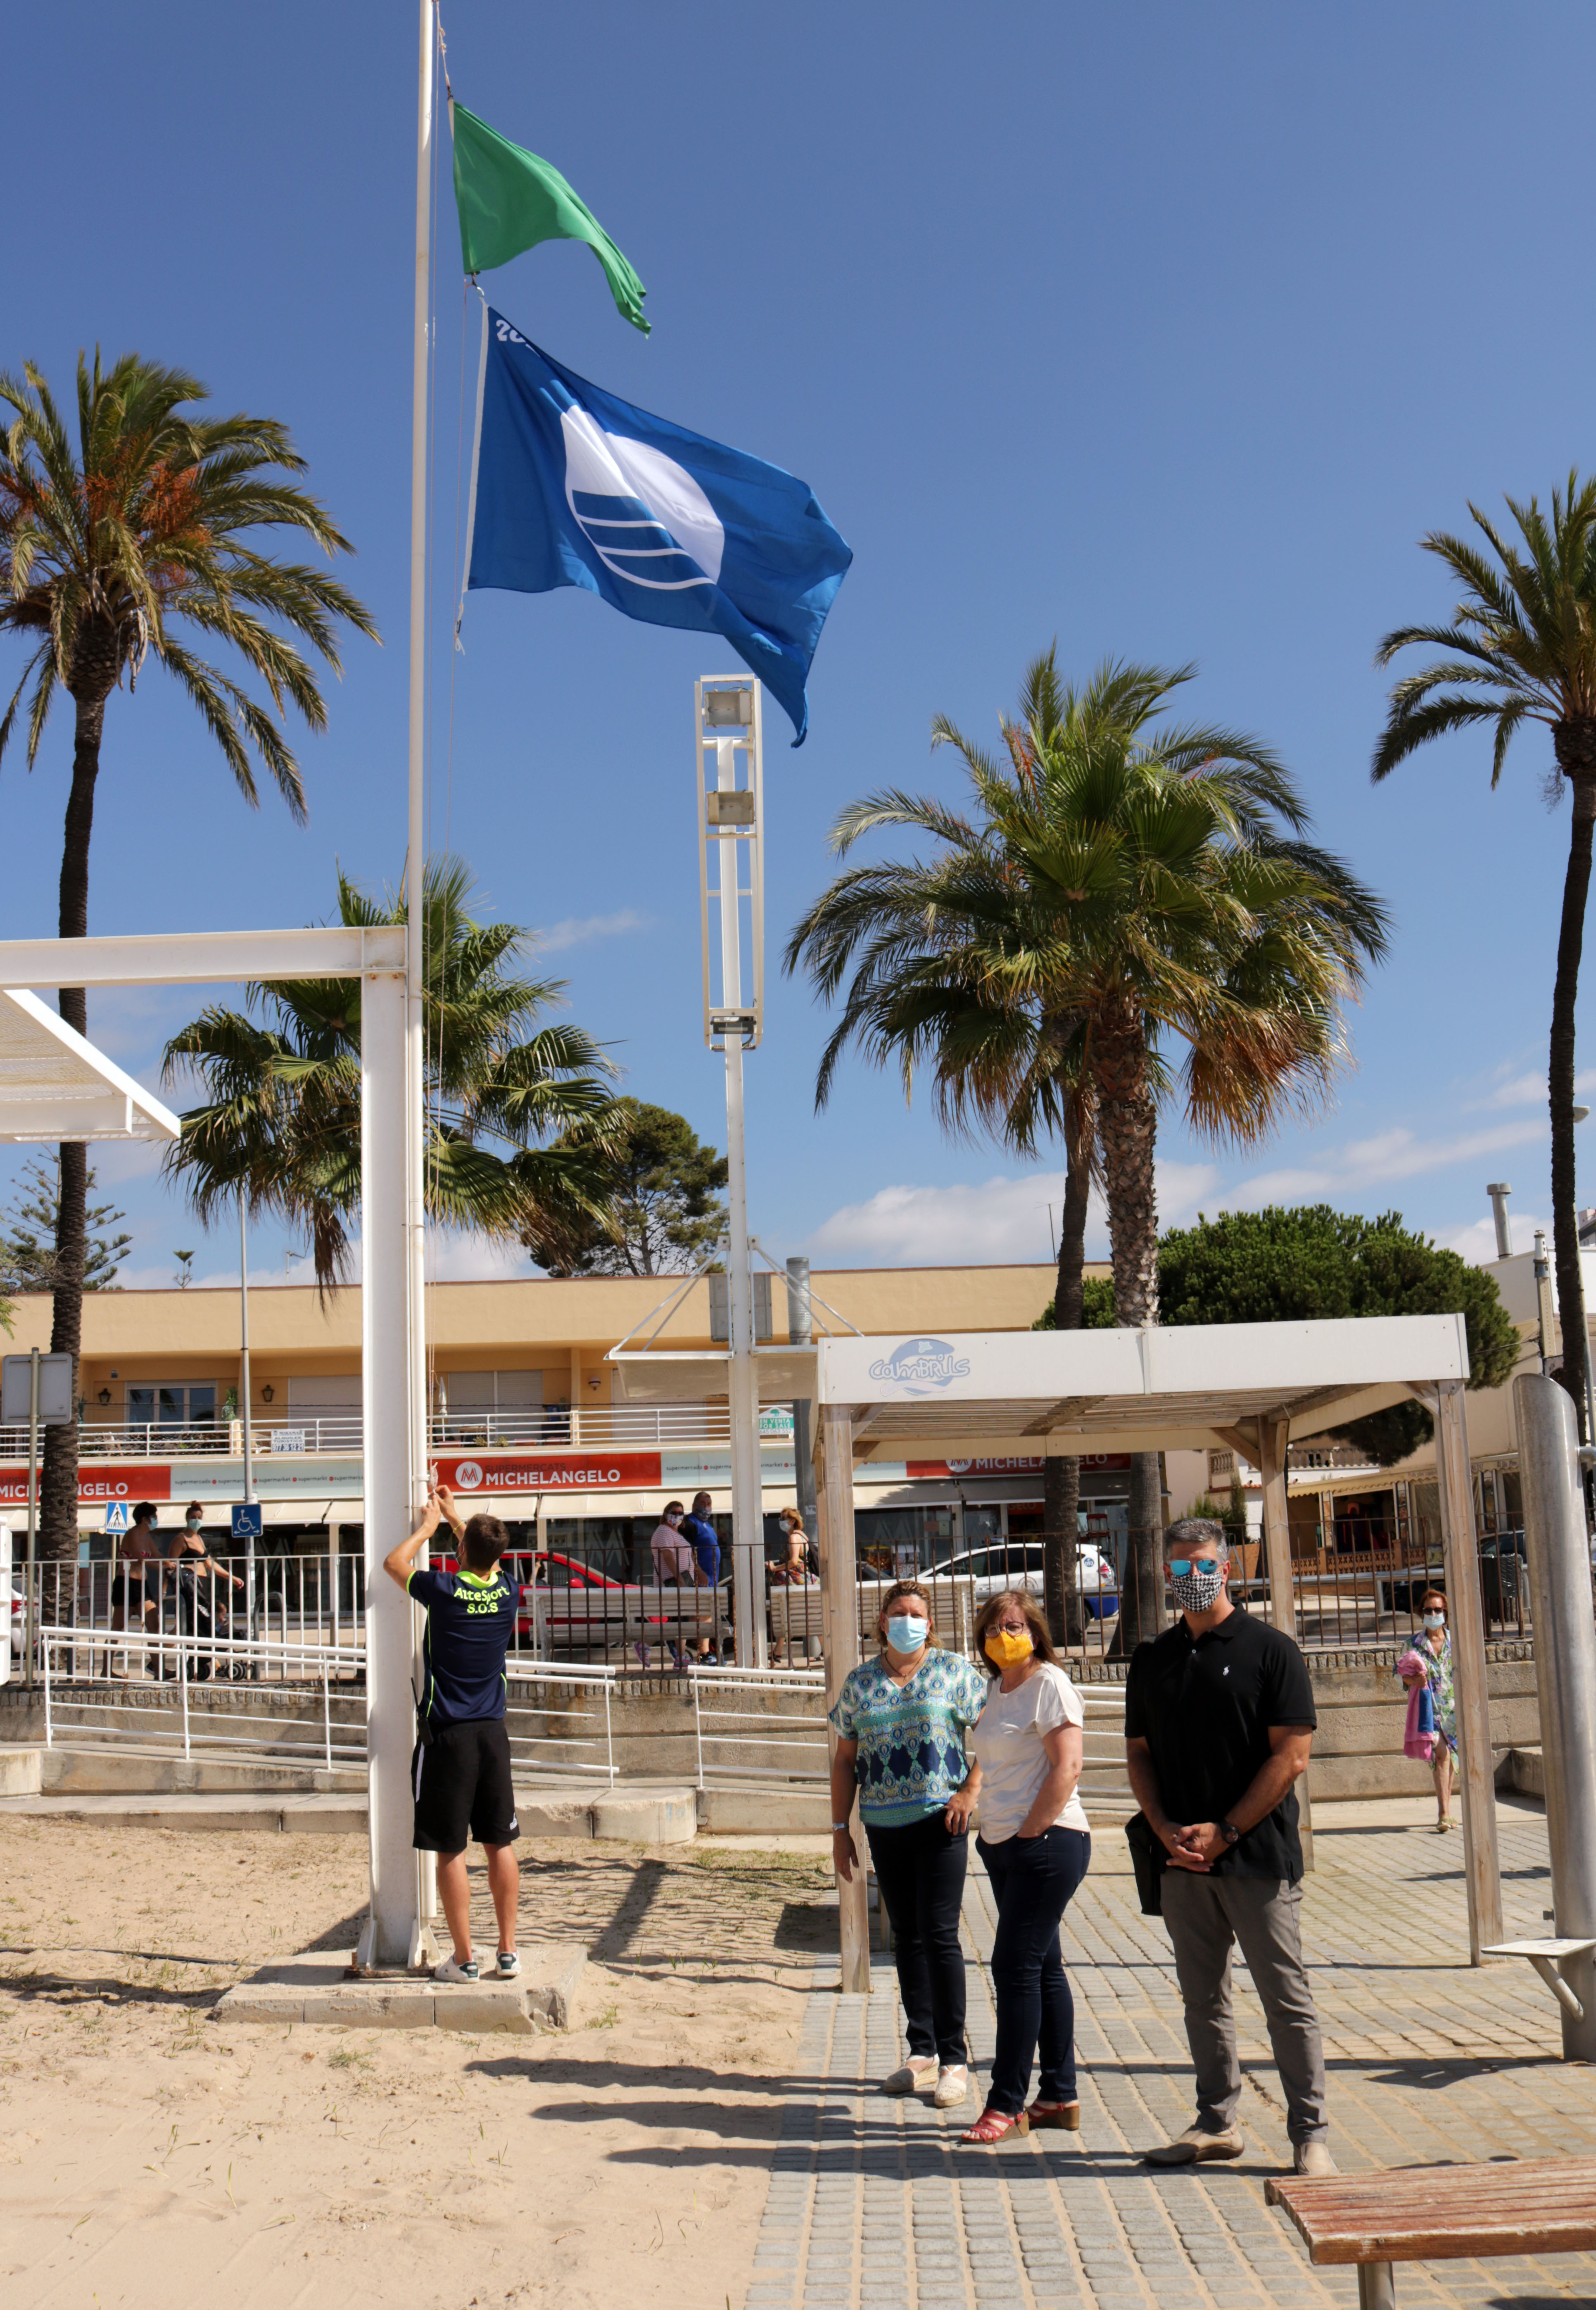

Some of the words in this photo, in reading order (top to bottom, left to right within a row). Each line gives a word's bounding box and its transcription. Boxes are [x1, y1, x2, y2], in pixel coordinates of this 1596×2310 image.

[485, 1463, 566, 1473] SUPERMERCATS
[486, 1469, 620, 1486] MICHELANGELO
[454, 1586, 510, 1605] AlteSport
[467, 1602, 499, 1614] S.O.S
